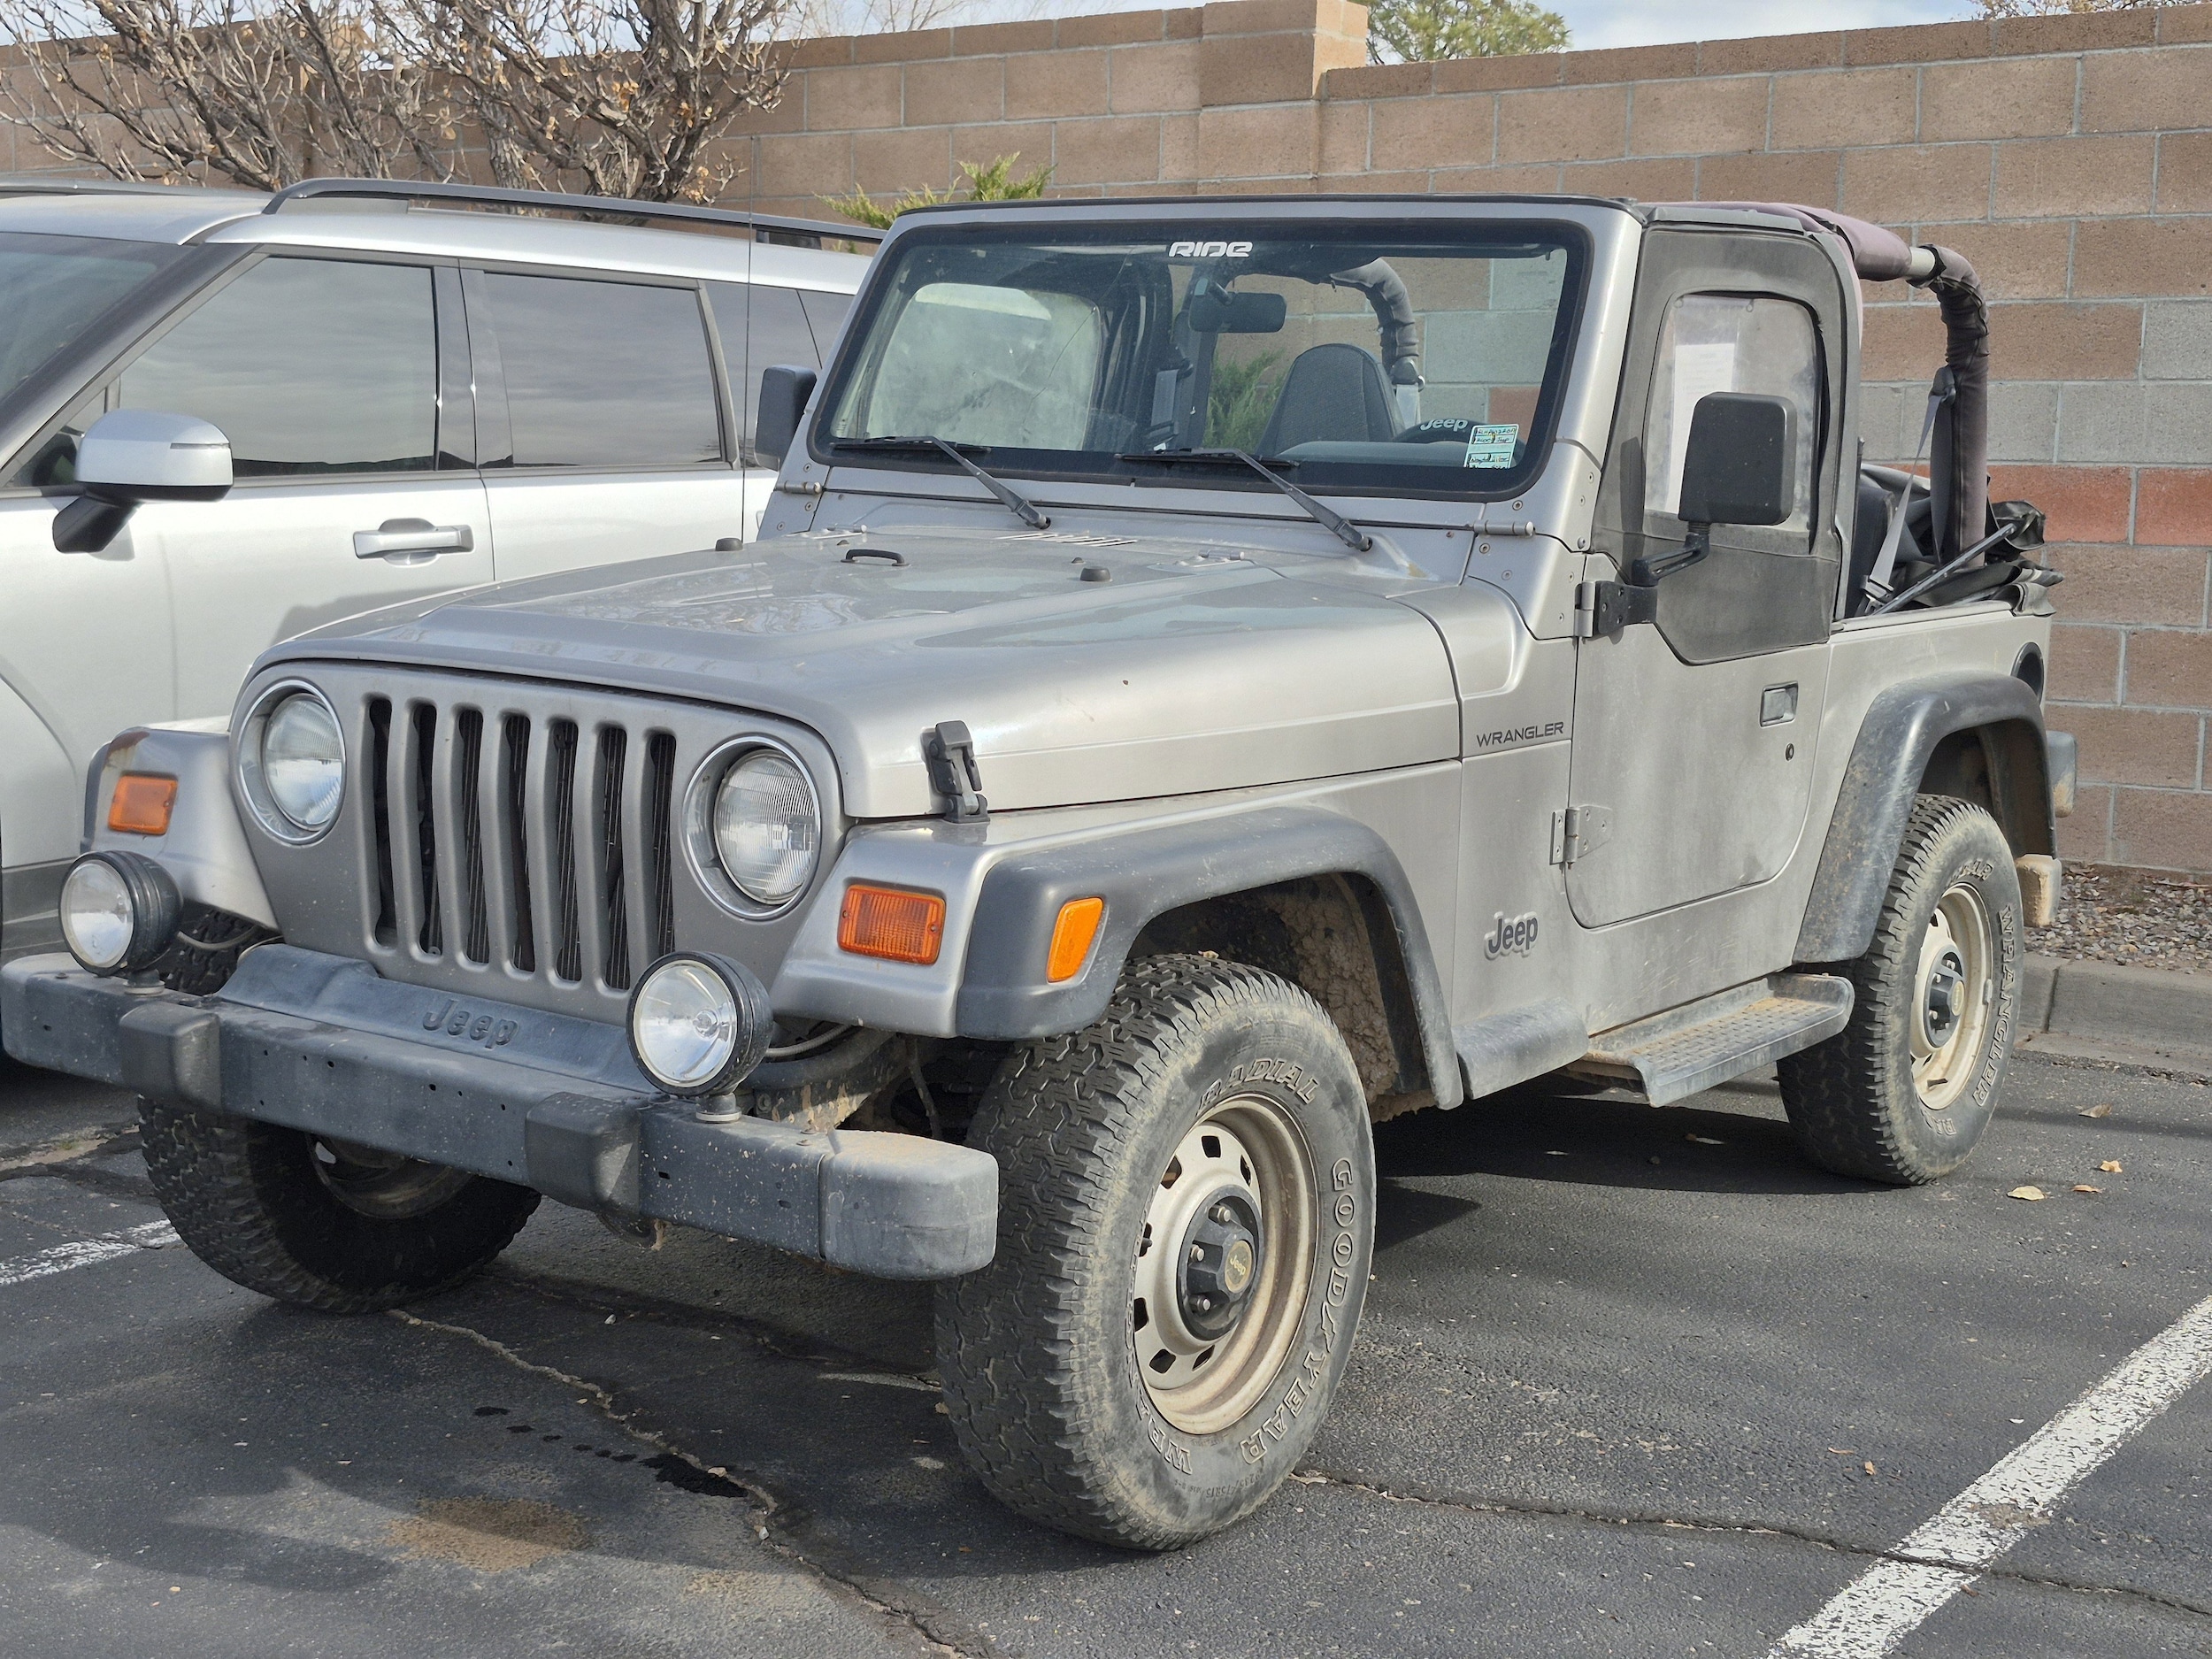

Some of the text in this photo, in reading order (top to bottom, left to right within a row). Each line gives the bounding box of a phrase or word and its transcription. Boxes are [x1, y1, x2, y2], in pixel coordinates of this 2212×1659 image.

[1420, 419, 1468, 432] Jeep
[1476, 721, 1564, 748] WRANGLER
[1486, 915, 1538, 956] Jeep
[422, 999, 518, 1049] Jeep
[1972, 904, 2016, 1106] WRANGLER
[1195, 1057, 1320, 1117] RADIAL
[1230, 1255, 1246, 1276] Jeep
[1239, 1157, 1356, 1464] GOODYEAR
